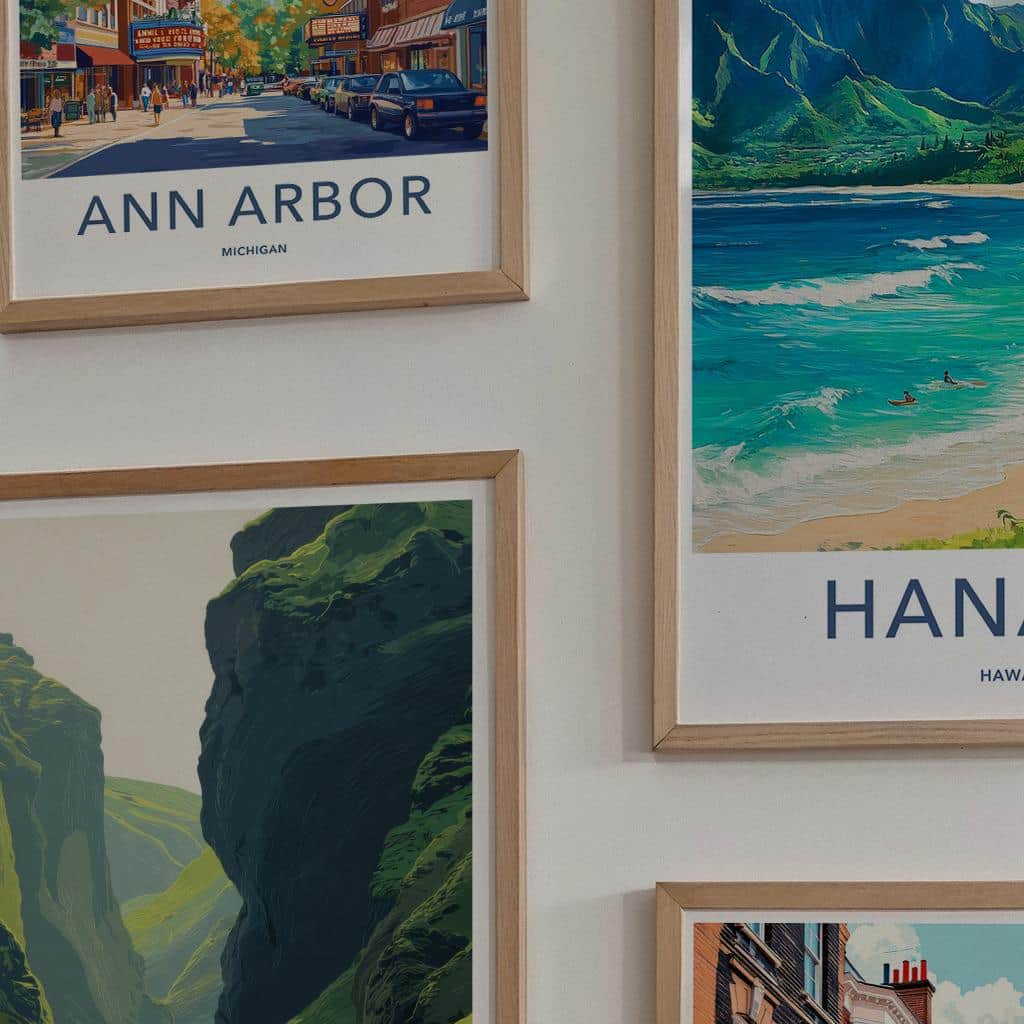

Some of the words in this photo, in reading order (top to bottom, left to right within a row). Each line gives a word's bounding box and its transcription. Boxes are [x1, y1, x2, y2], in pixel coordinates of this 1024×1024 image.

[77, 188, 205, 236] ANN
[228, 175, 432, 226] ARBOR
[221, 244, 288, 257] MICHIGAN
[827, 577, 1024, 639] HAN
[980, 669, 1024, 682] HAW
